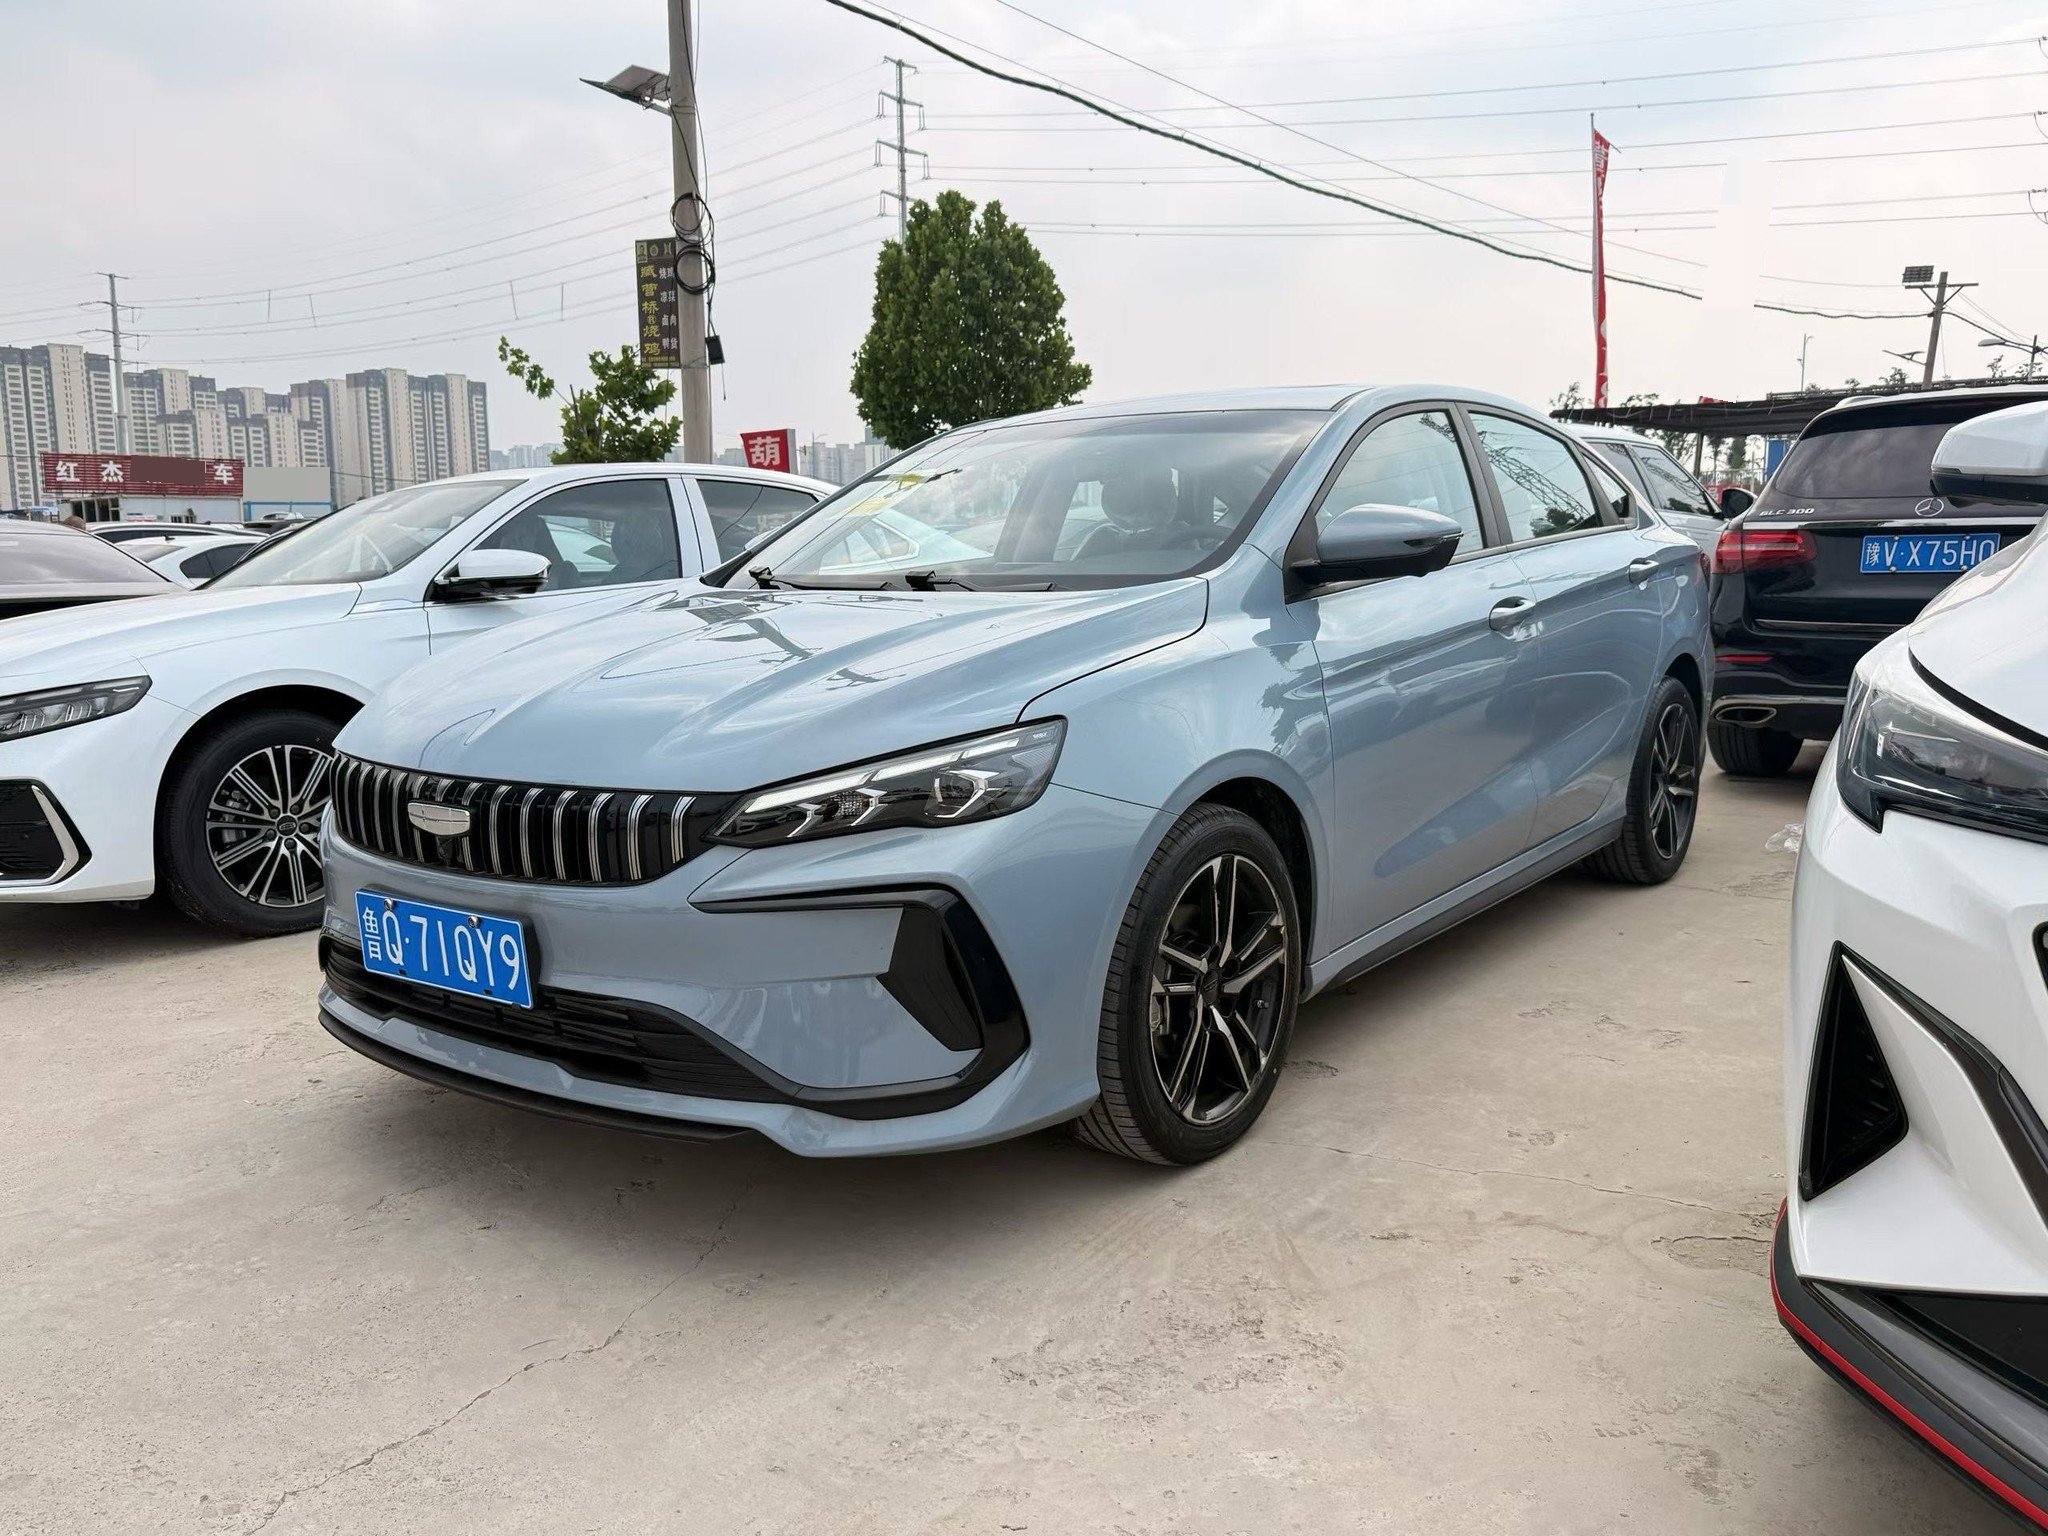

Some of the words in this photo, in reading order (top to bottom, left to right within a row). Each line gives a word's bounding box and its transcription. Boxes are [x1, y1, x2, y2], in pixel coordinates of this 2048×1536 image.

[748, 435, 781, 467] 葫
[213, 463, 235, 485] 车
[1759, 509, 1786, 517] GLC
[1786, 507, 1815, 515] 300
[361, 906, 520, 991] 鲁Q·71QY9
